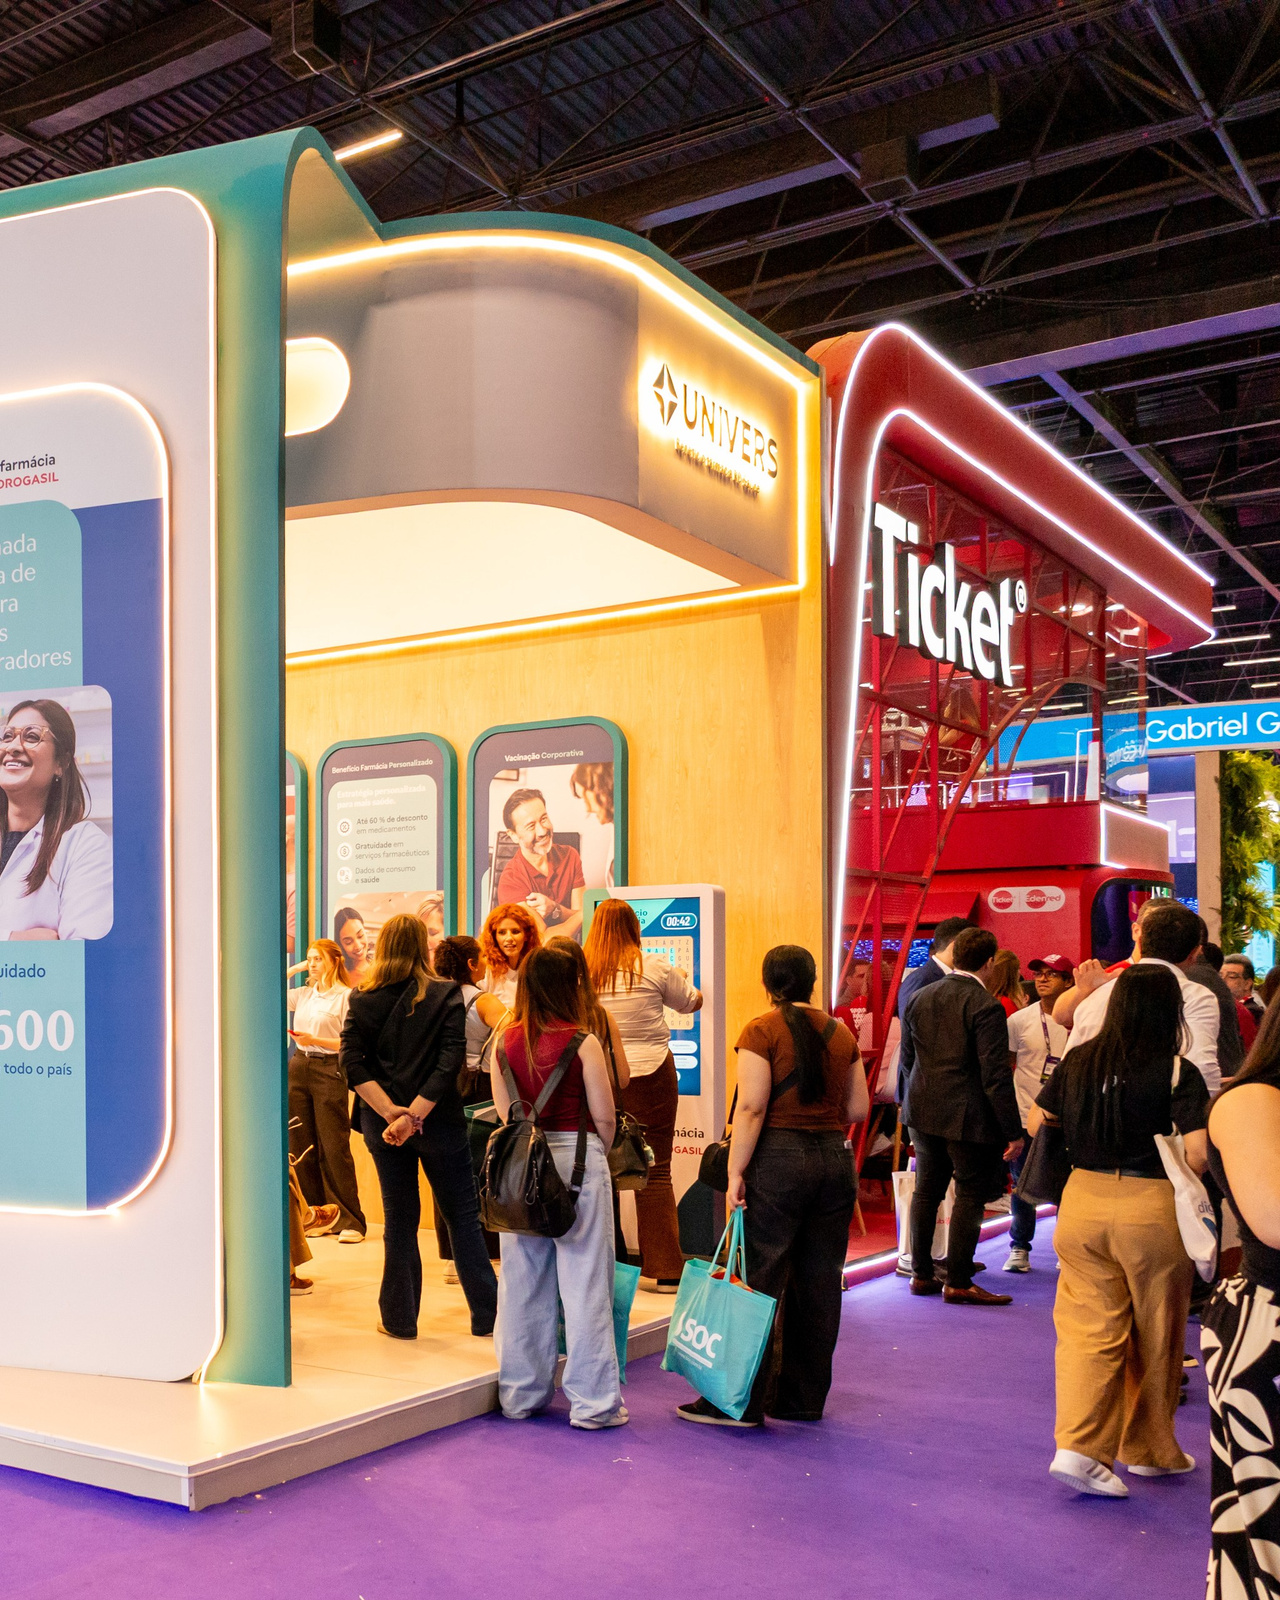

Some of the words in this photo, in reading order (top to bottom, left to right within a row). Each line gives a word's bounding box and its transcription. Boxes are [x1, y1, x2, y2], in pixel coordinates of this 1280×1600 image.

[683, 383, 778, 479] UNIVERS
[0, 454, 56, 473] farmácia
[11, 562, 36, 583] de
[1146, 712, 1247, 743] Gabriel
[504, 752, 540, 762] Vacinação
[541, 749, 584, 760] Corporativa
[332, 764, 359, 774] Benefício
[360, 762, 388, 772] Farmácia
[389, 758, 433, 769] Personalizado
[374, 784, 426, 797] personalizada
[337, 801, 353, 810] para
[356, 817, 368, 825] Até
[369, 816, 378, 824] 60
[386, 815, 396, 823] de
[397, 814, 428, 822] desconto
[368, 825, 416, 834] medicamentos
[355, 842, 392, 850] Gratuidade
[355, 852, 382, 860] serviços
[382, 849, 430, 859] farmacêuticos
[355, 867, 375, 875] Dados
[376, 866, 385, 874] de
[360, 876, 380, 884] saúde
[1025, 894, 1061, 902] Edenred
[666, 916, 691, 926] 00:42
[4, 1062, 33, 1075] todo
[36, 1064, 44, 1075] o
[48, 1063, 72, 1078] país
[674, 1146, 704, 1155] GASIL
[680, 1318, 723, 1359] SOC
